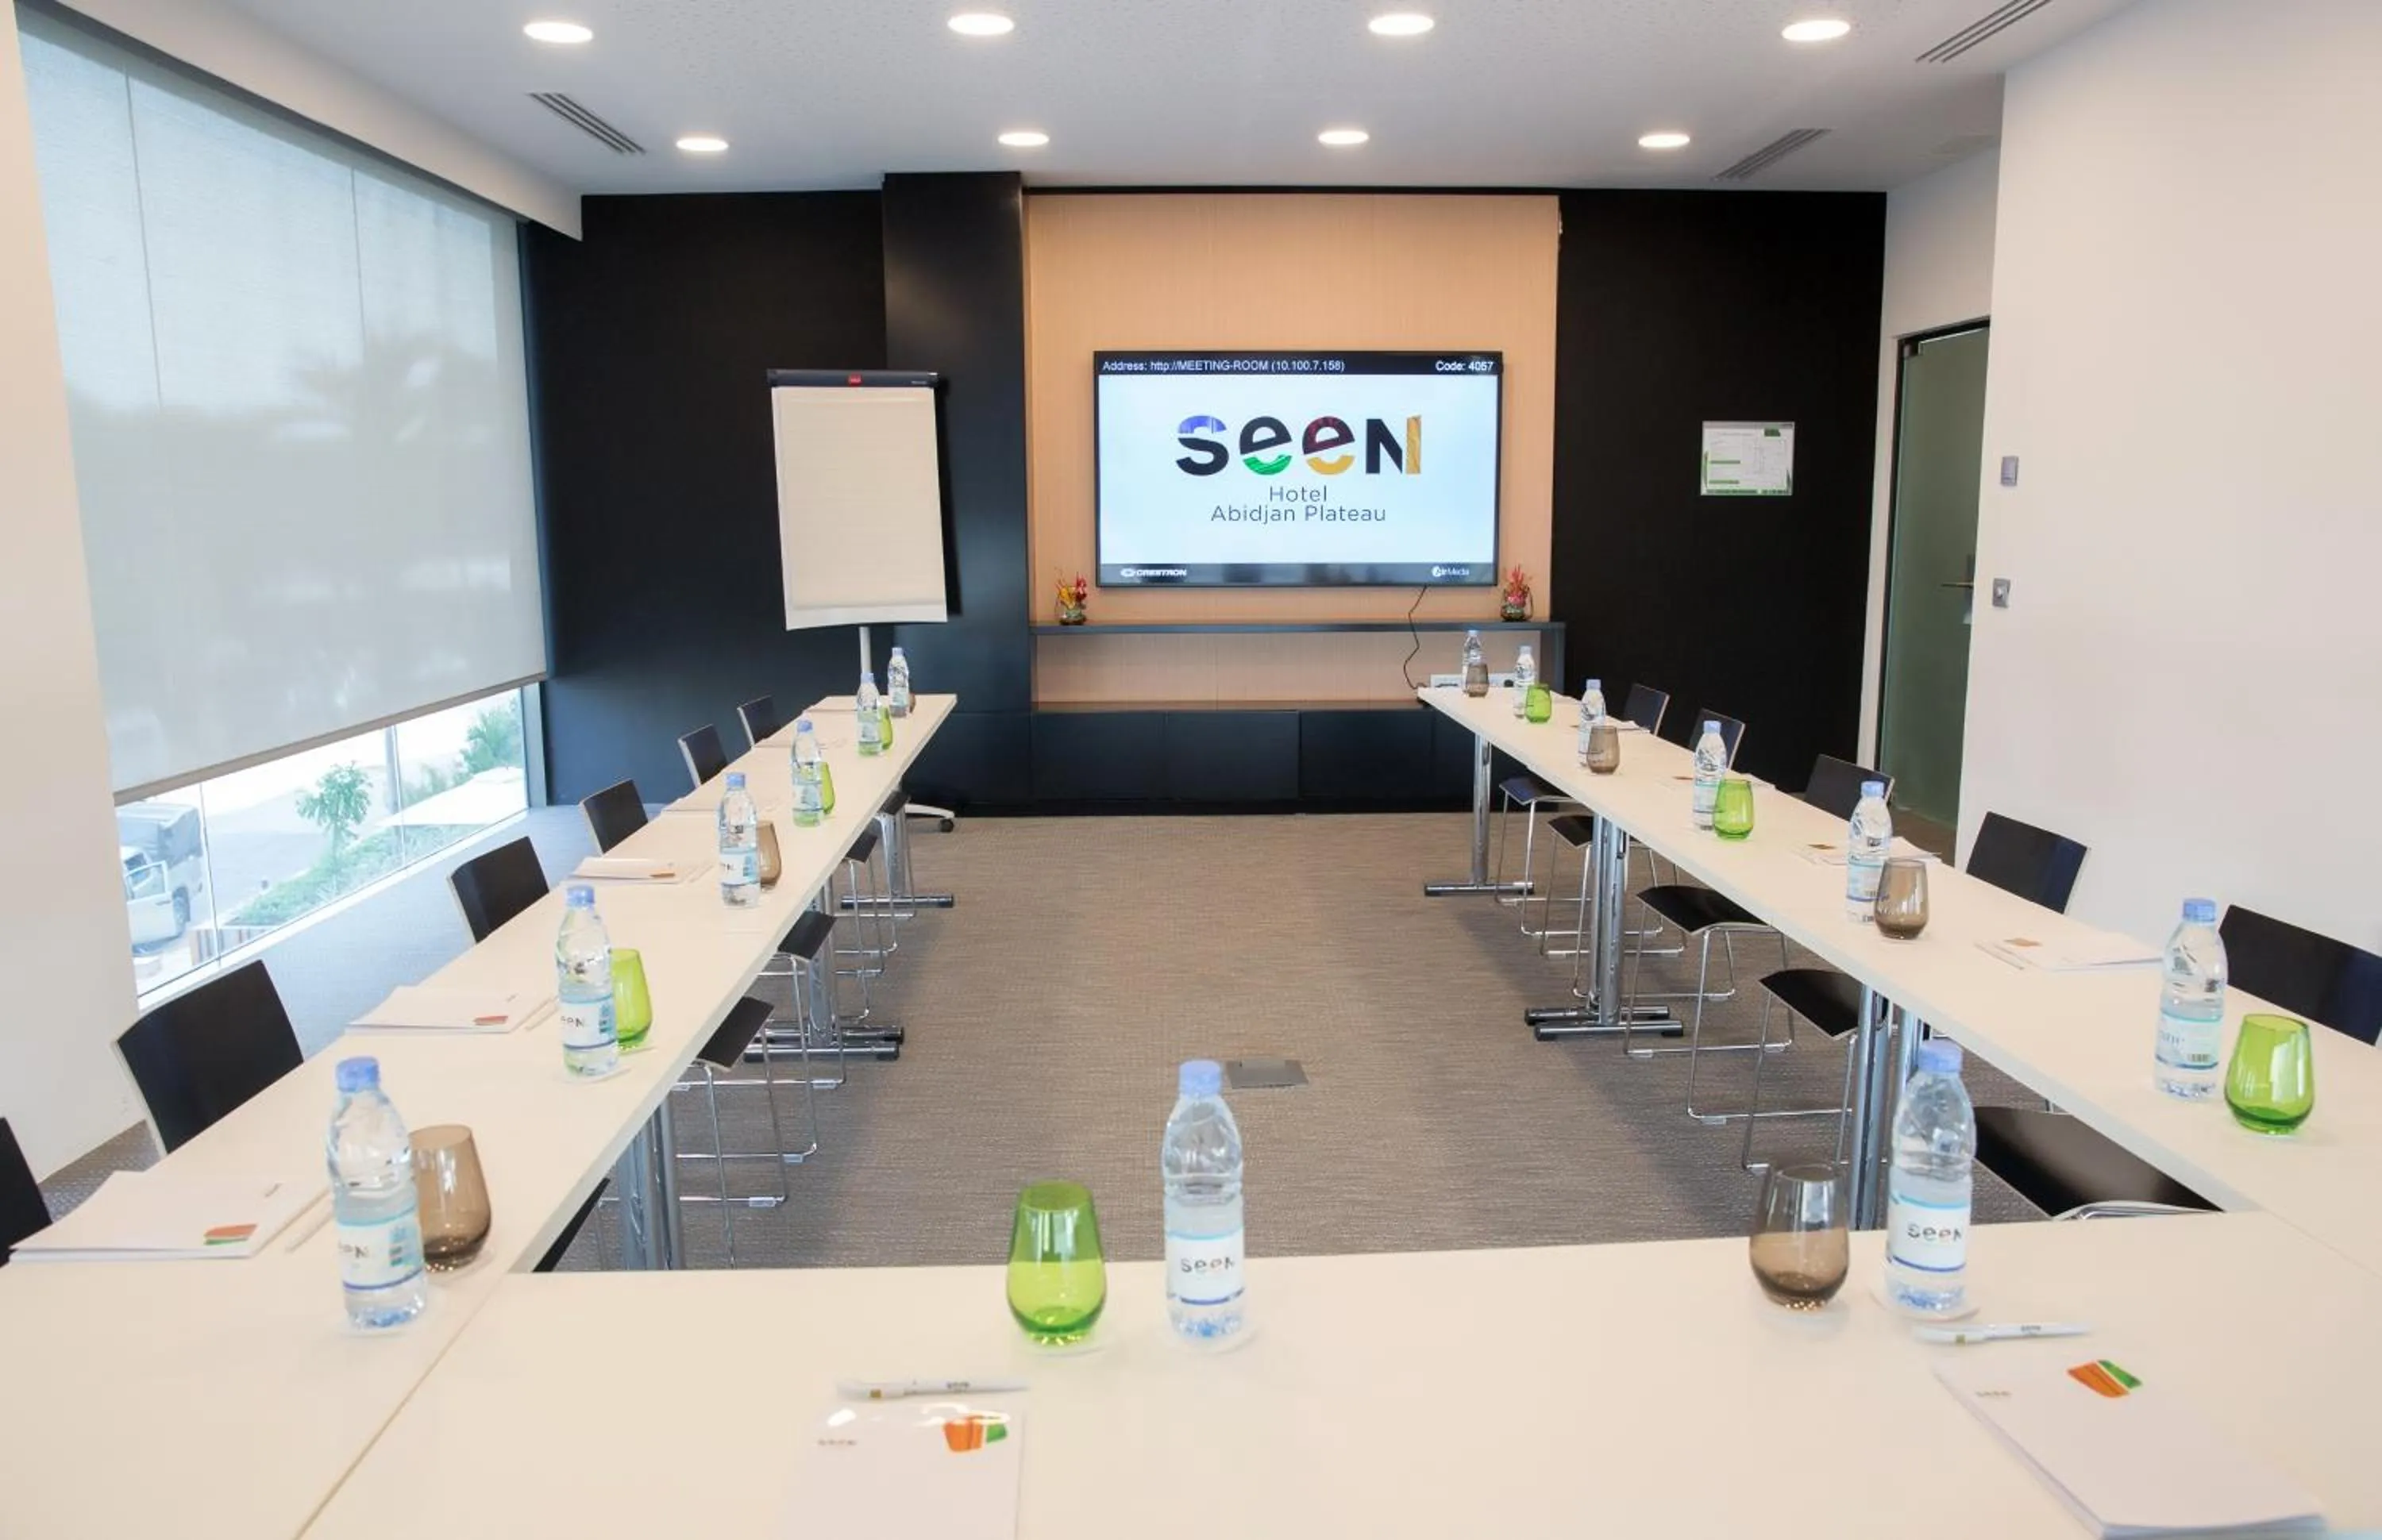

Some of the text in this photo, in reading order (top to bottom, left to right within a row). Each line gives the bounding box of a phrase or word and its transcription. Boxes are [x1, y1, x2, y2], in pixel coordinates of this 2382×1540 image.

[1101, 360, 1148, 372] Address:
[1435, 360, 1466, 372] Code:
[1269, 485, 1328, 502] Hotel
[1210, 505, 1386, 525] Abidjan Plateau
